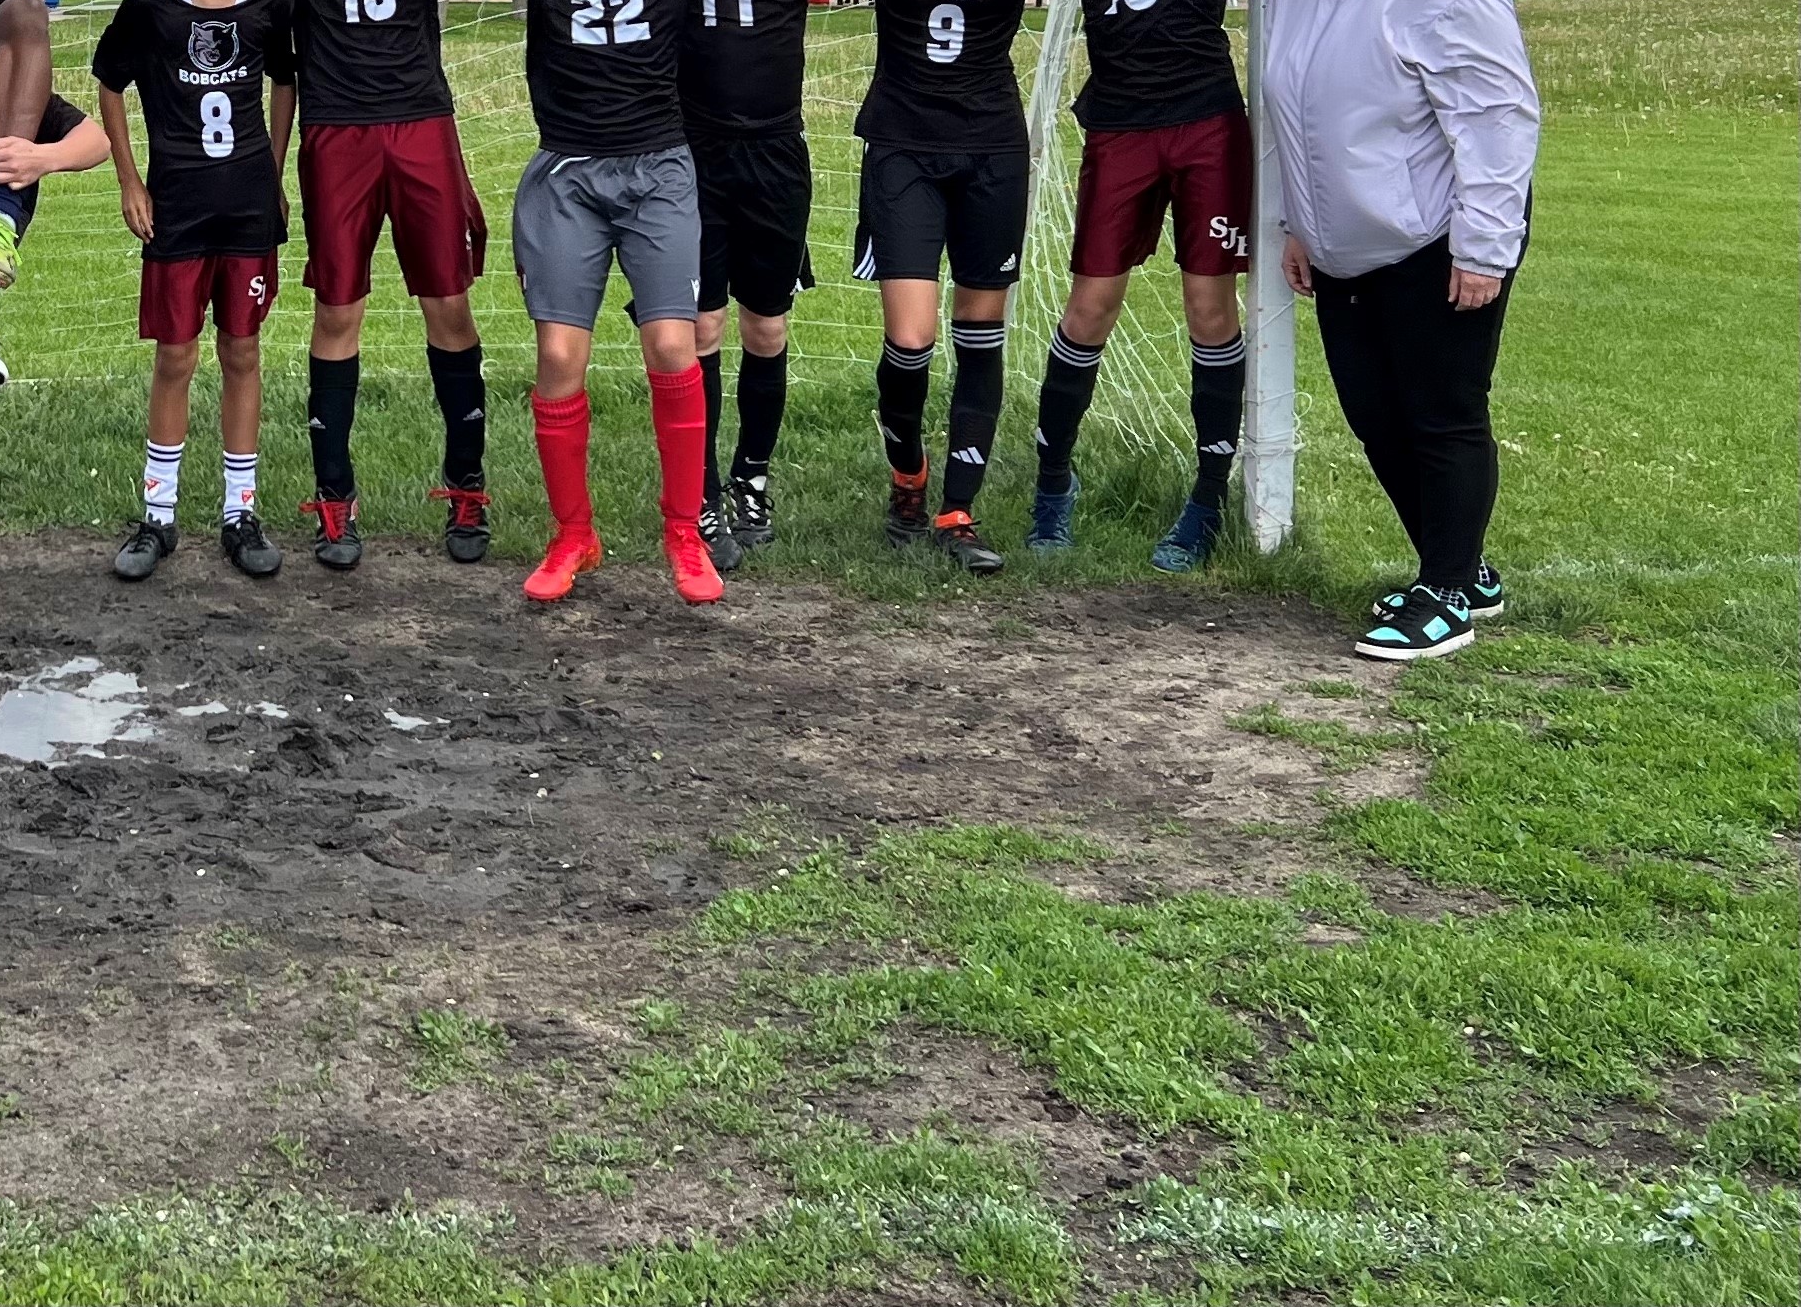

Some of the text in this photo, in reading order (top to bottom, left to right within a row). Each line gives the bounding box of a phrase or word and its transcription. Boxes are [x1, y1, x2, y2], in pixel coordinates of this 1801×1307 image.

[926, 3, 965, 63] 9
[179, 66, 248, 85] BOBCATS
[200, 91, 234, 158] 8
